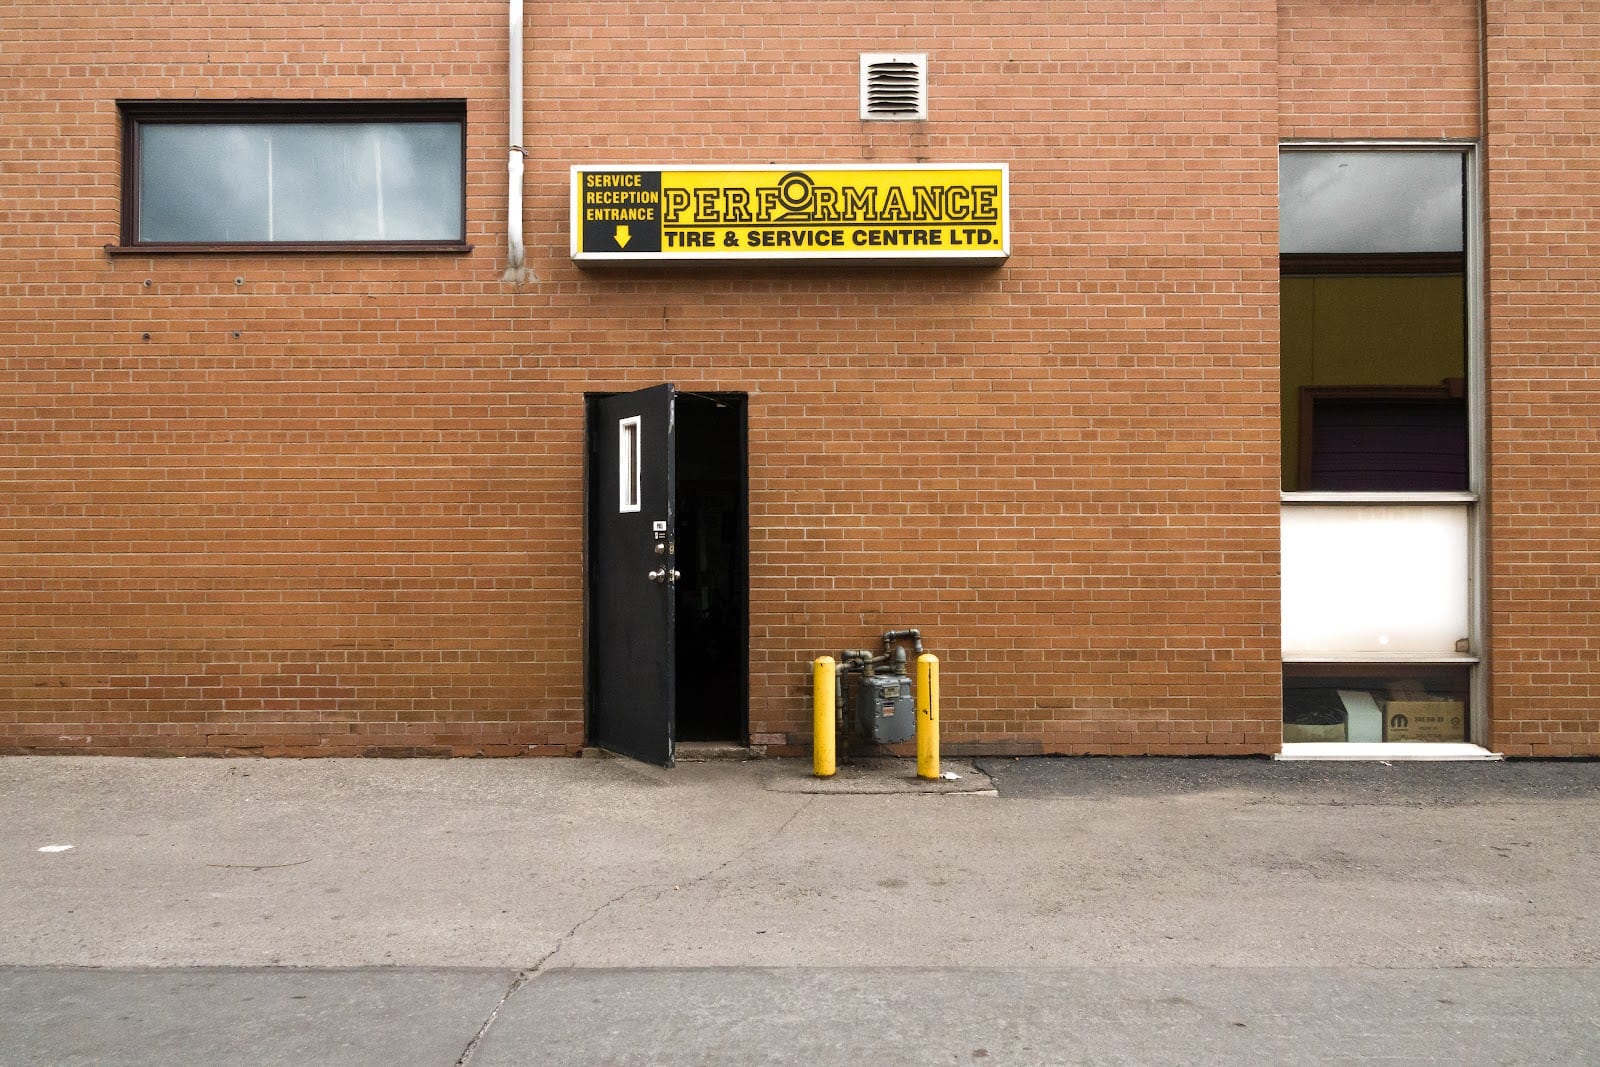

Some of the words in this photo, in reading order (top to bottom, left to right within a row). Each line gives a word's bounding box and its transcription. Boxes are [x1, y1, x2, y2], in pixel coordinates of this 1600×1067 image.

[587, 174, 642, 188] SERVICE
[587, 191, 659, 204] RECEPTION
[664, 171, 998, 223] PERFORMANCE
[587, 207, 655, 221] ENTRANCE
[664, 231, 715, 247] TIRE
[723, 230, 739, 247] &
[747, 230, 845, 247] SERVICE
[852, 229, 942, 246] CENTRE
[950, 229, 999, 245] LTD.
